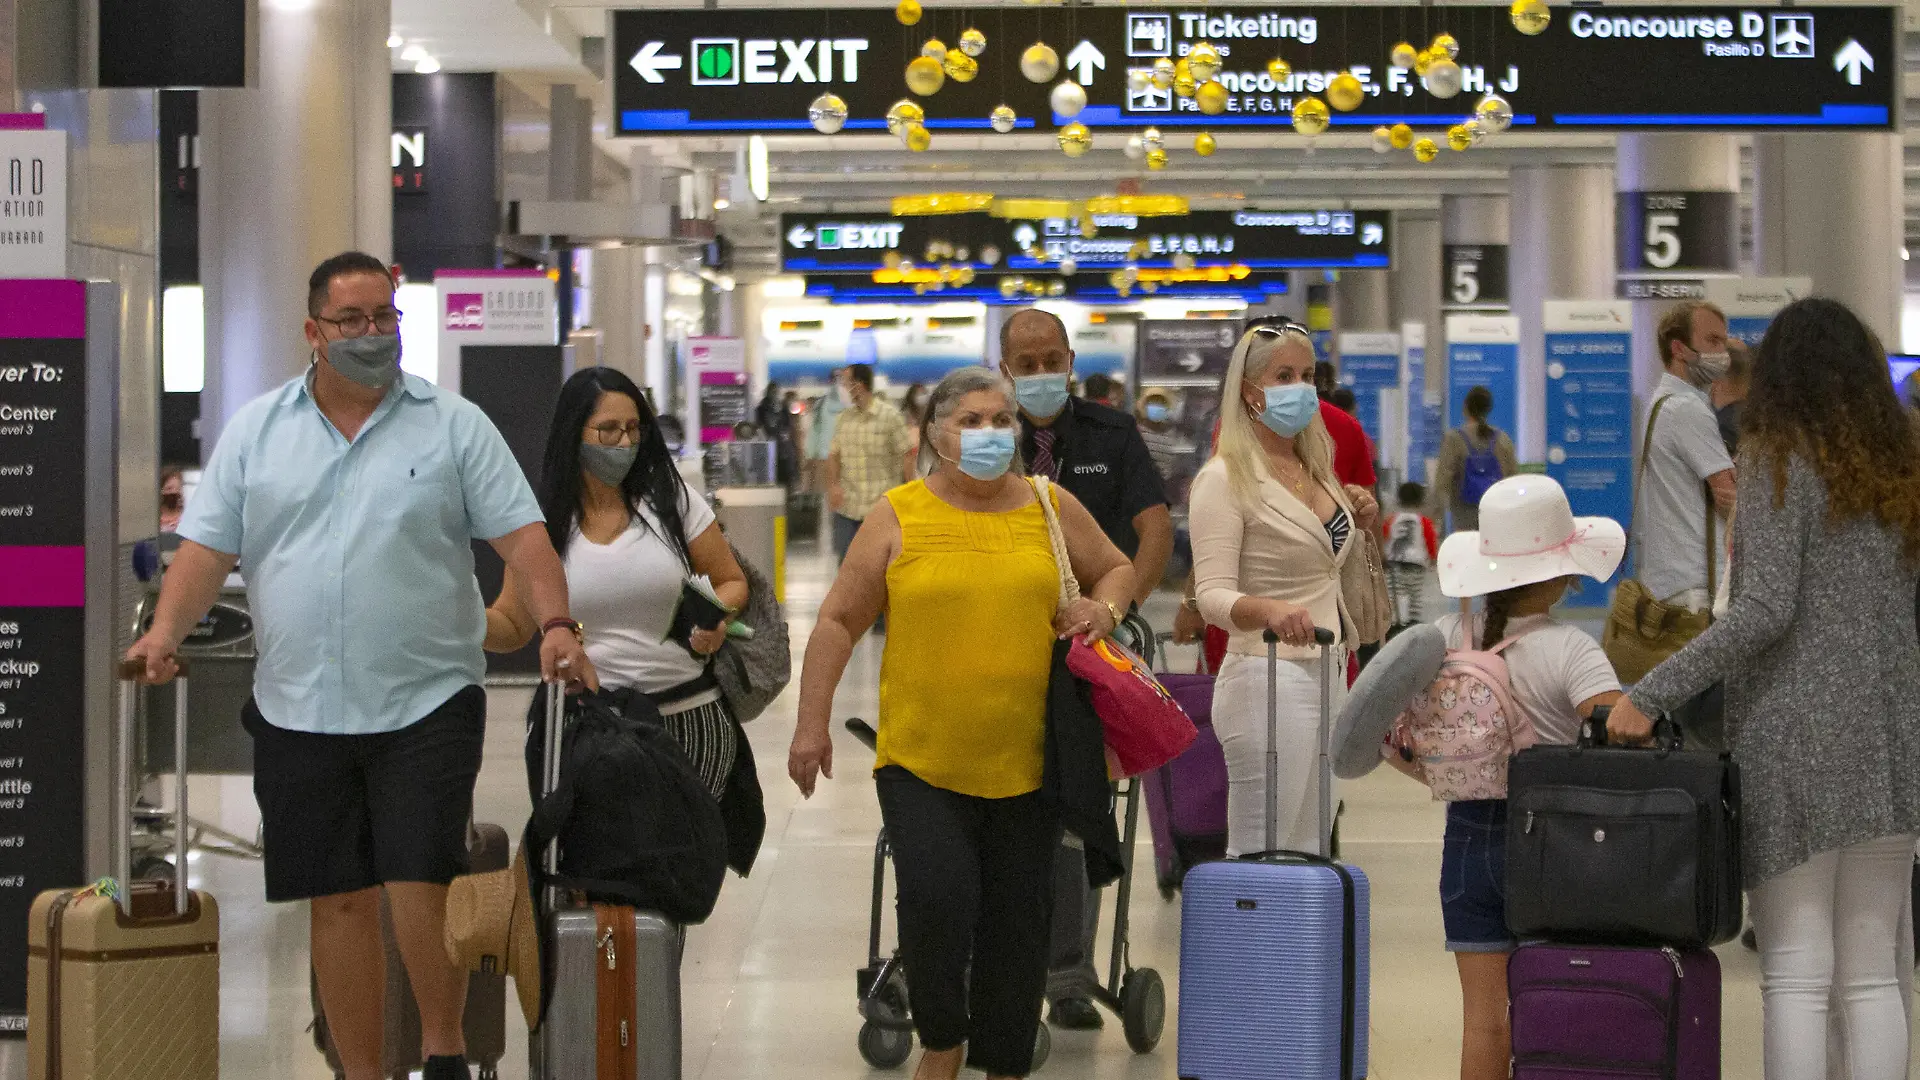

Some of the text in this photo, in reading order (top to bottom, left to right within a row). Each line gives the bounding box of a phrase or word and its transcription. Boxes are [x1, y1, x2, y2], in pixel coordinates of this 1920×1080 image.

[1179, 14, 1317, 44] Ticketing
[1570, 12, 1764, 38] Concourse D
[1704, 44, 1765, 57] Pasillo D
[745, 39, 868, 83] EXIT
[1196, 72, 1337, 92] ncours
[1387, 67, 1413, 97] F,
[1499, 67, 1518, 92] J
[0, 200, 44, 217] ATION
[1646, 197, 1686, 210] ZONE
[1235, 211, 1330, 227] Concourse D
[841, 222, 904, 249] EXIT
[1645, 214, 1681, 268] 5
[1069, 239, 1134, 253] Concour
[1223, 237, 1234, 253] J
[1453, 264, 1479, 304] 5
[32, 363, 63, 382] To:
[0, 404, 57, 421] Center
[26, 425, 34, 436] 3
[26, 465, 34, 476] 3
[1074, 464, 1108, 475] envoy
[26, 505, 34, 516] 3
